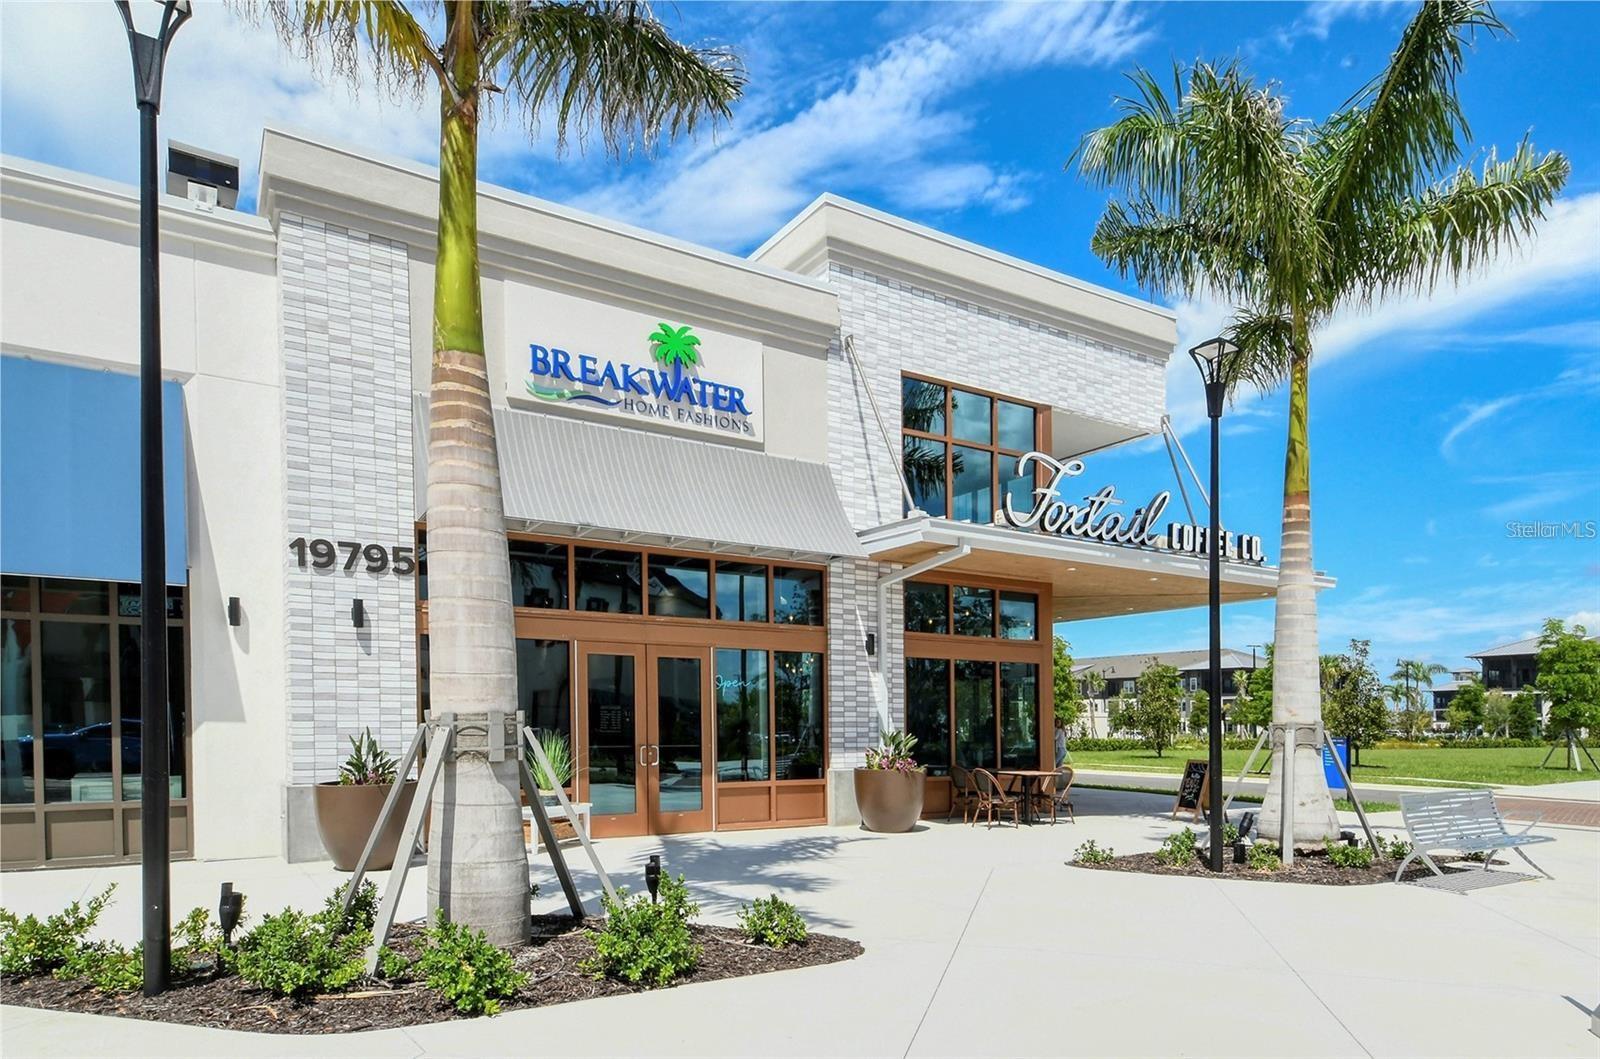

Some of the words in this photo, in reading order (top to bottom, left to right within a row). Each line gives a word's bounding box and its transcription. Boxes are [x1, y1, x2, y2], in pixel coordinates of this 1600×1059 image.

[530, 344, 752, 416] BREAKWATER
[624, 398, 670, 418] HOME
[677, 410, 750, 432] FASHIONS
[1005, 451, 1170, 546] Foxtail
[289, 537, 416, 575] 19795
[715, 674, 752, 697] Open
